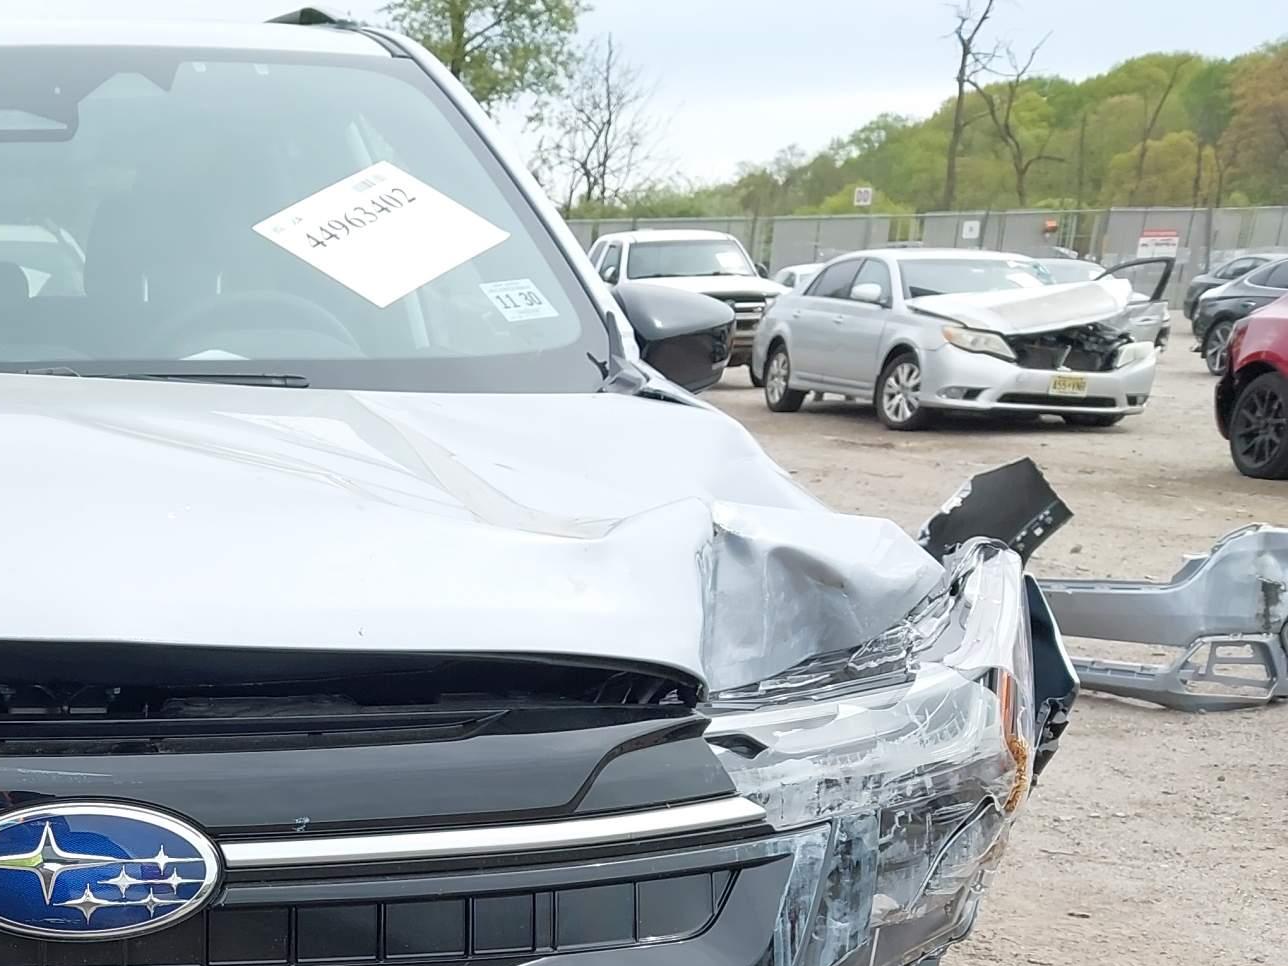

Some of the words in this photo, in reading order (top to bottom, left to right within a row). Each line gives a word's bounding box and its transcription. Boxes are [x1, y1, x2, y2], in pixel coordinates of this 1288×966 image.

[305, 187, 417, 248] 44963402
[495, 294, 521, 309] 11
[518, 291, 543, 306] 30
